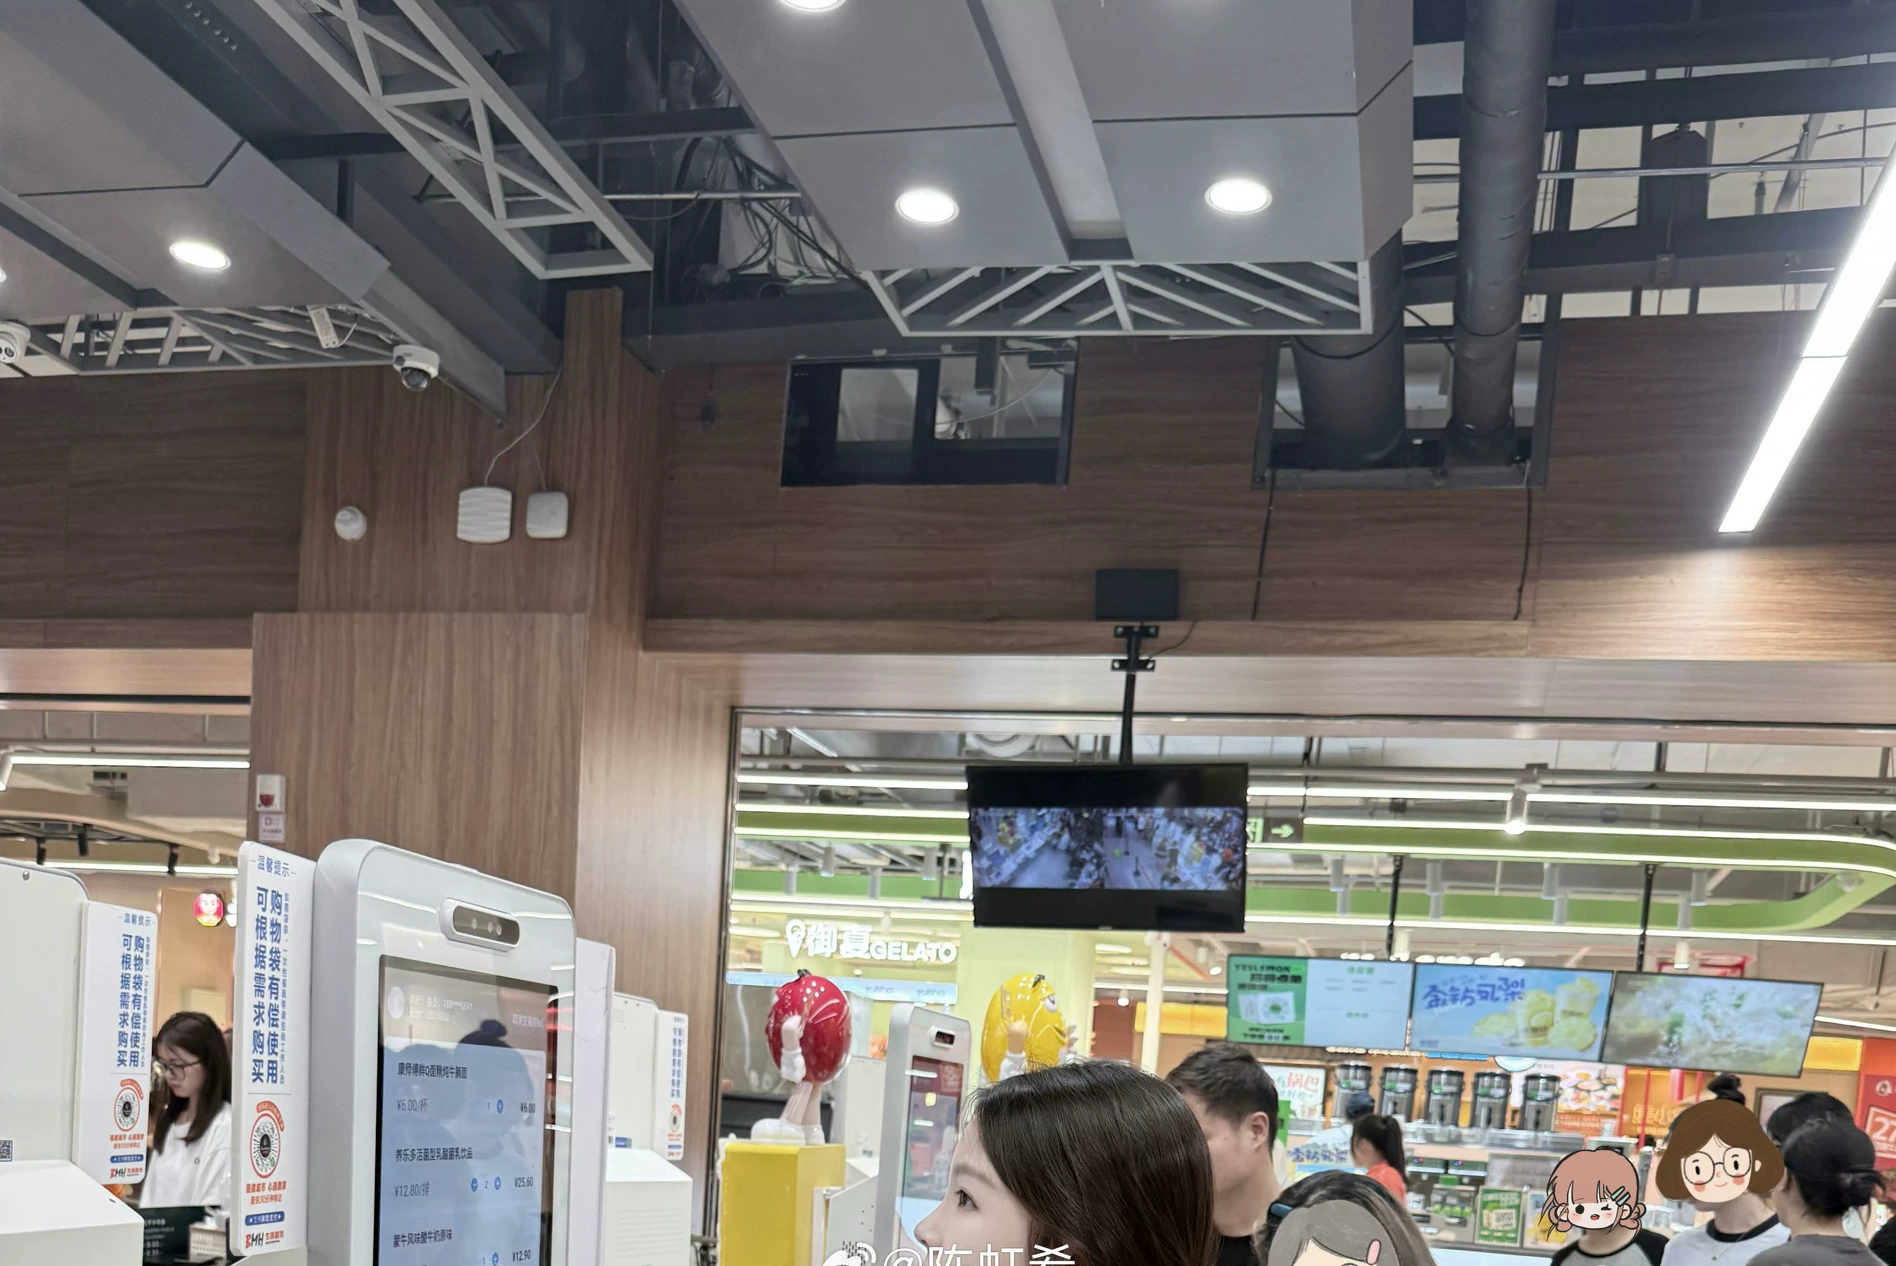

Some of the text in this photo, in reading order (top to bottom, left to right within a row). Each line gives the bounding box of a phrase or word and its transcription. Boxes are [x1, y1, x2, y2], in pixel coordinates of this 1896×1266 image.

[257, 855, 290, 877] 温馨提示
[868, 940, 958, 964] GELATO
[252, 886, 269, 1084] 可根据需求购买
[266, 889, 283, 1084] 购物袋有偿使用
[117, 933, 133, 1068] 可根据需求购买
[129, 935, 145, 1068] 购物袋有偿使用
[520, 1102, 536, 1114] ¥6.00
[245, 1232, 265, 1249] BMH
[512, 1250, 531, 1262] ¥12.90
